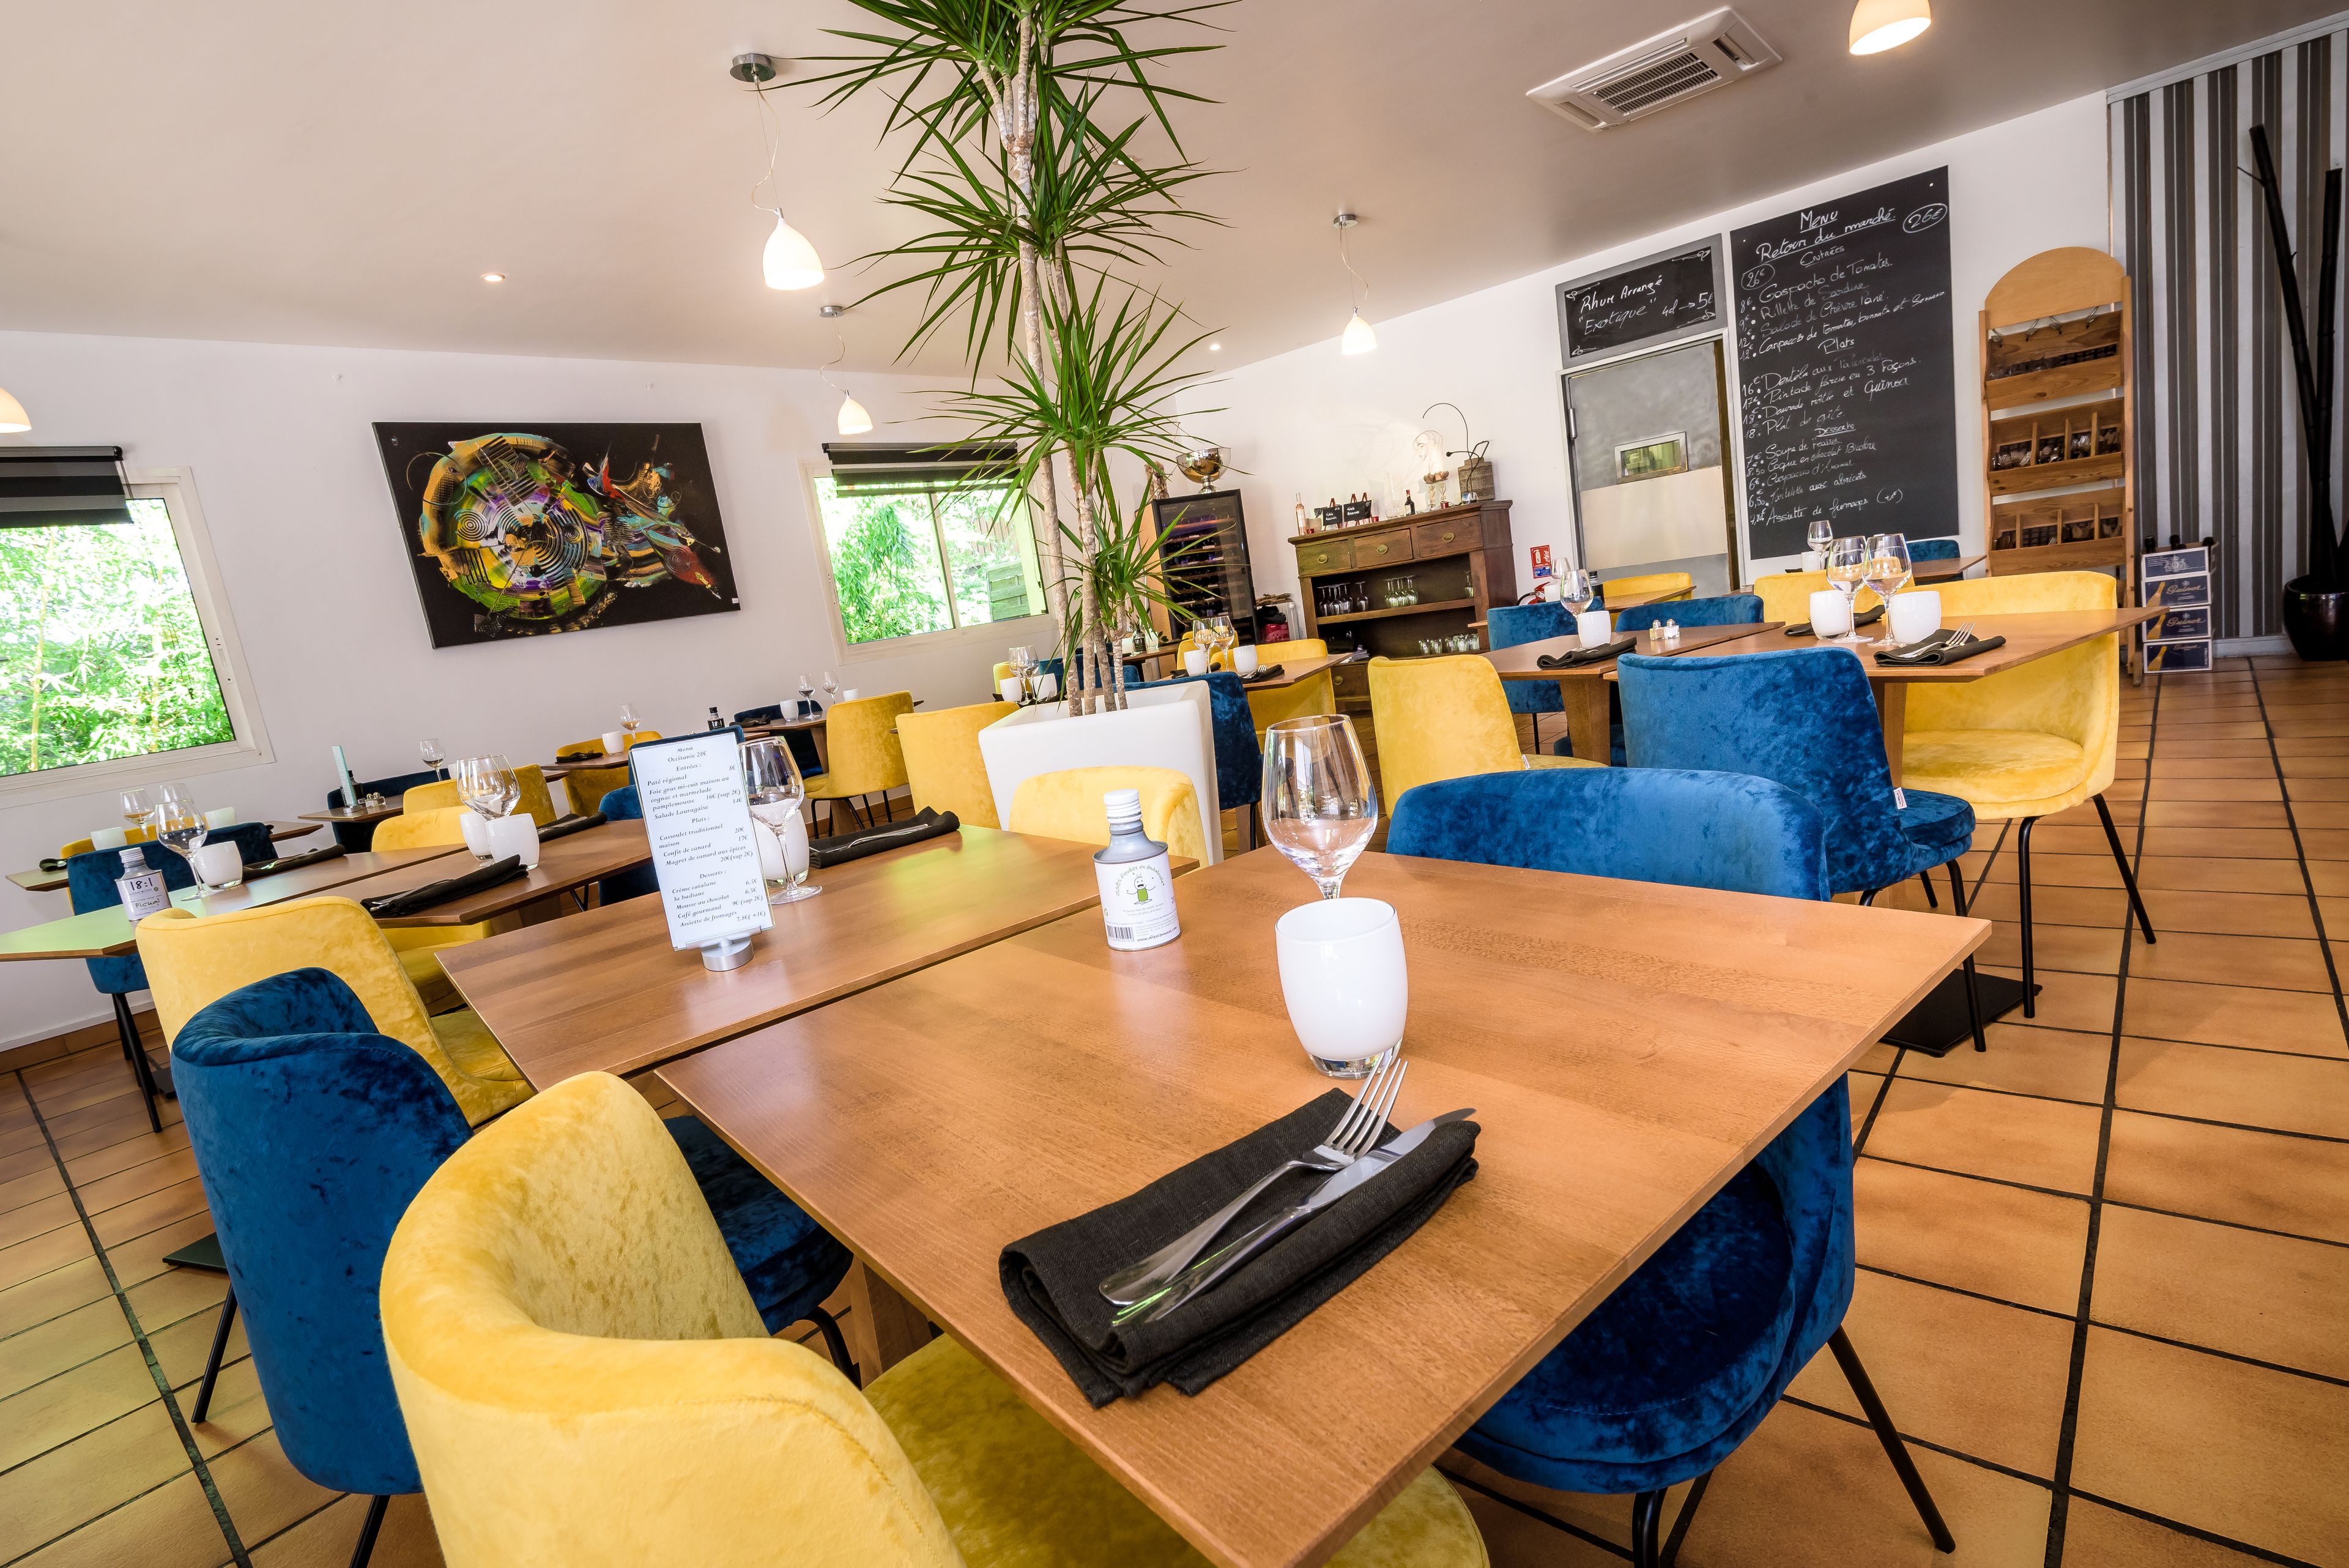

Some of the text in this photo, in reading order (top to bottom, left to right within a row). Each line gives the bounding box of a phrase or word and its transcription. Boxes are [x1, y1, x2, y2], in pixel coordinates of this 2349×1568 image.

[1800, 210, 1838, 230] Menu
[1909, 208, 1943, 229] 26€
[1756, 239, 1806, 262] Retour
[1814, 228, 1836, 245] du
[1830, 265, 1846, 281] de
[1620, 275, 1663, 299] Arrangé
[1804, 294, 1816, 307] de
[1817, 337, 1855, 353] Plats
[1866, 365, 1876, 376] 3
[1843, 385, 1854, 398] et
[1798, 438, 1809, 452] de
[1812, 505, 1822, 516] de
[667, 753, 696, 762] Occitanie
[676, 763, 699, 771] Entrées
[662, 774, 687, 784] régional
[650, 795, 672, 804] cognac
[679, 787, 712, 797] marmelade
[653, 798, 695, 812] pamplemousse
[717, 791, 730, 800] (sup
[654, 811, 675, 820] Salade
[676, 805, 709, 816] Lauragaise
[659, 831, 687, 841] Cassoulet
[688, 823, 723, 835] traditionnel
[691, 842, 711, 852] canard
[666, 857, 687, 866] Magret
[696, 850, 717, 860] canard
[729, 845, 746, 855] épices
[699, 871, 723, 879] Desserts
[130, 877, 154, 891] 18:1
[691, 880, 716, 890] catalane
[135, 897, 161, 908] Picual
[675, 902, 697, 910] Mousse
[707, 894, 729, 903] chocolat
[681, 891, 705, 900] badiane
[678, 910, 691, 920] Café
[692, 904, 722, 917] gourmand
[680, 918, 703, 927] Assiette
[710, 911, 738, 923] fromages
